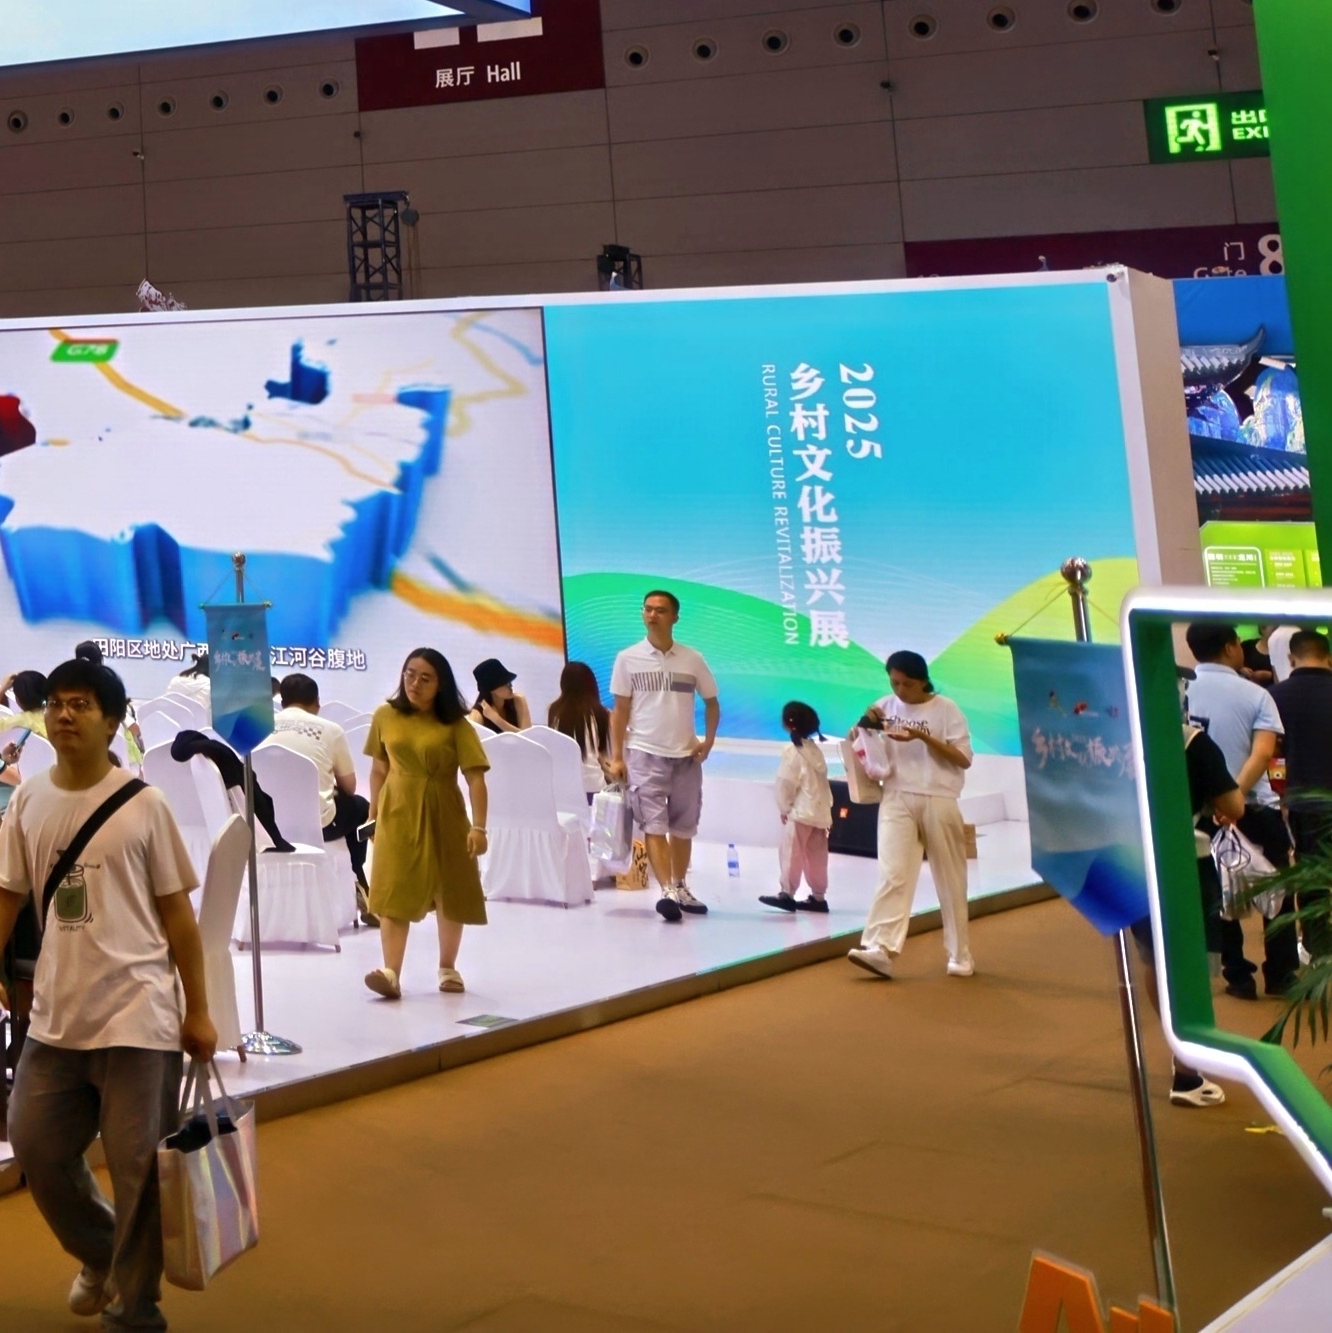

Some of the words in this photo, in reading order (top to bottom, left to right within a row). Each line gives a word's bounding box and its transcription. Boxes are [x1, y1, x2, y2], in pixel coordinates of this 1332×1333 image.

[436, 66, 475, 88] 展厅
[487, 61, 521, 83] Hall
[1232, 125, 1270, 140] EXI
[1223, 241, 1245, 261] 门
[762, 364, 778, 418] RURAL
[839, 363, 882, 459] 2025
[766, 425, 786, 499] CULTURE
[789, 362, 850, 649] 乡村文化振兴展
[774, 506, 799, 645] REVITALIZATION
